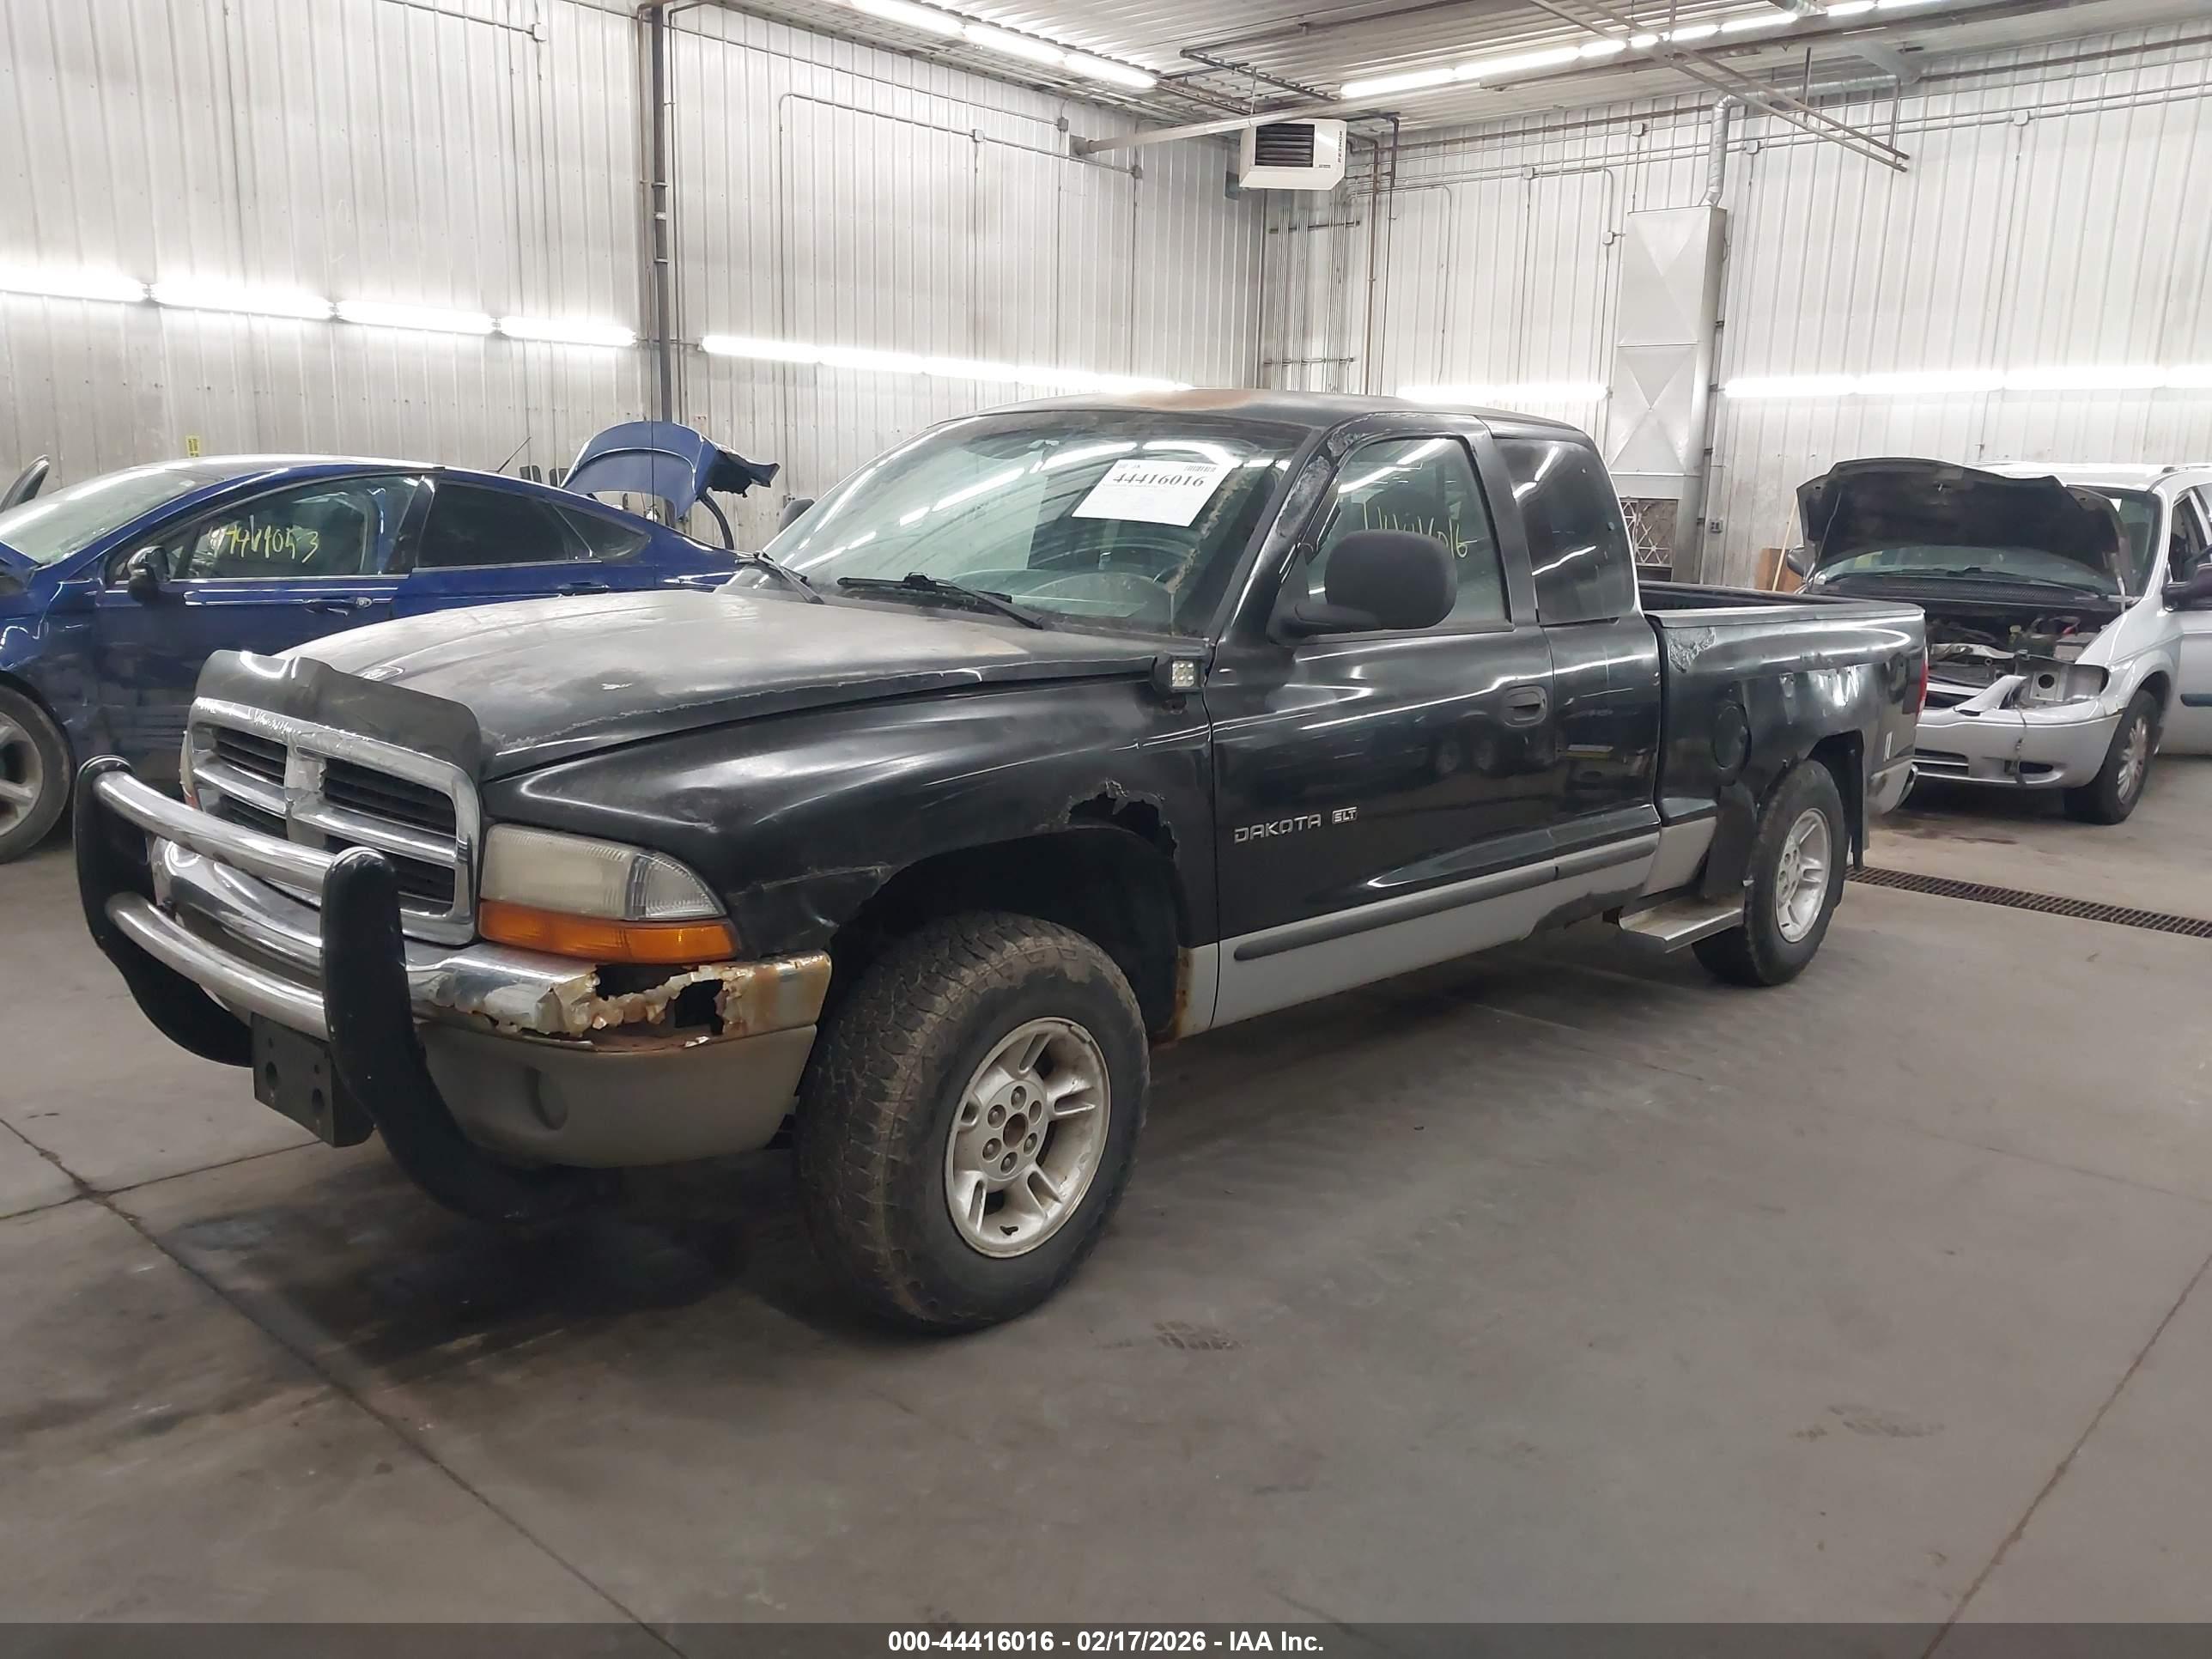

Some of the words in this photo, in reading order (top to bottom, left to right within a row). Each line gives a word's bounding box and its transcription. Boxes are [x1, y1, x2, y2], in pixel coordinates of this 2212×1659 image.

[1113, 472, 1208, 488] 44416016
[1234, 813, 1322, 843] DAKOTA
[1334, 808, 1358, 823] SLT
